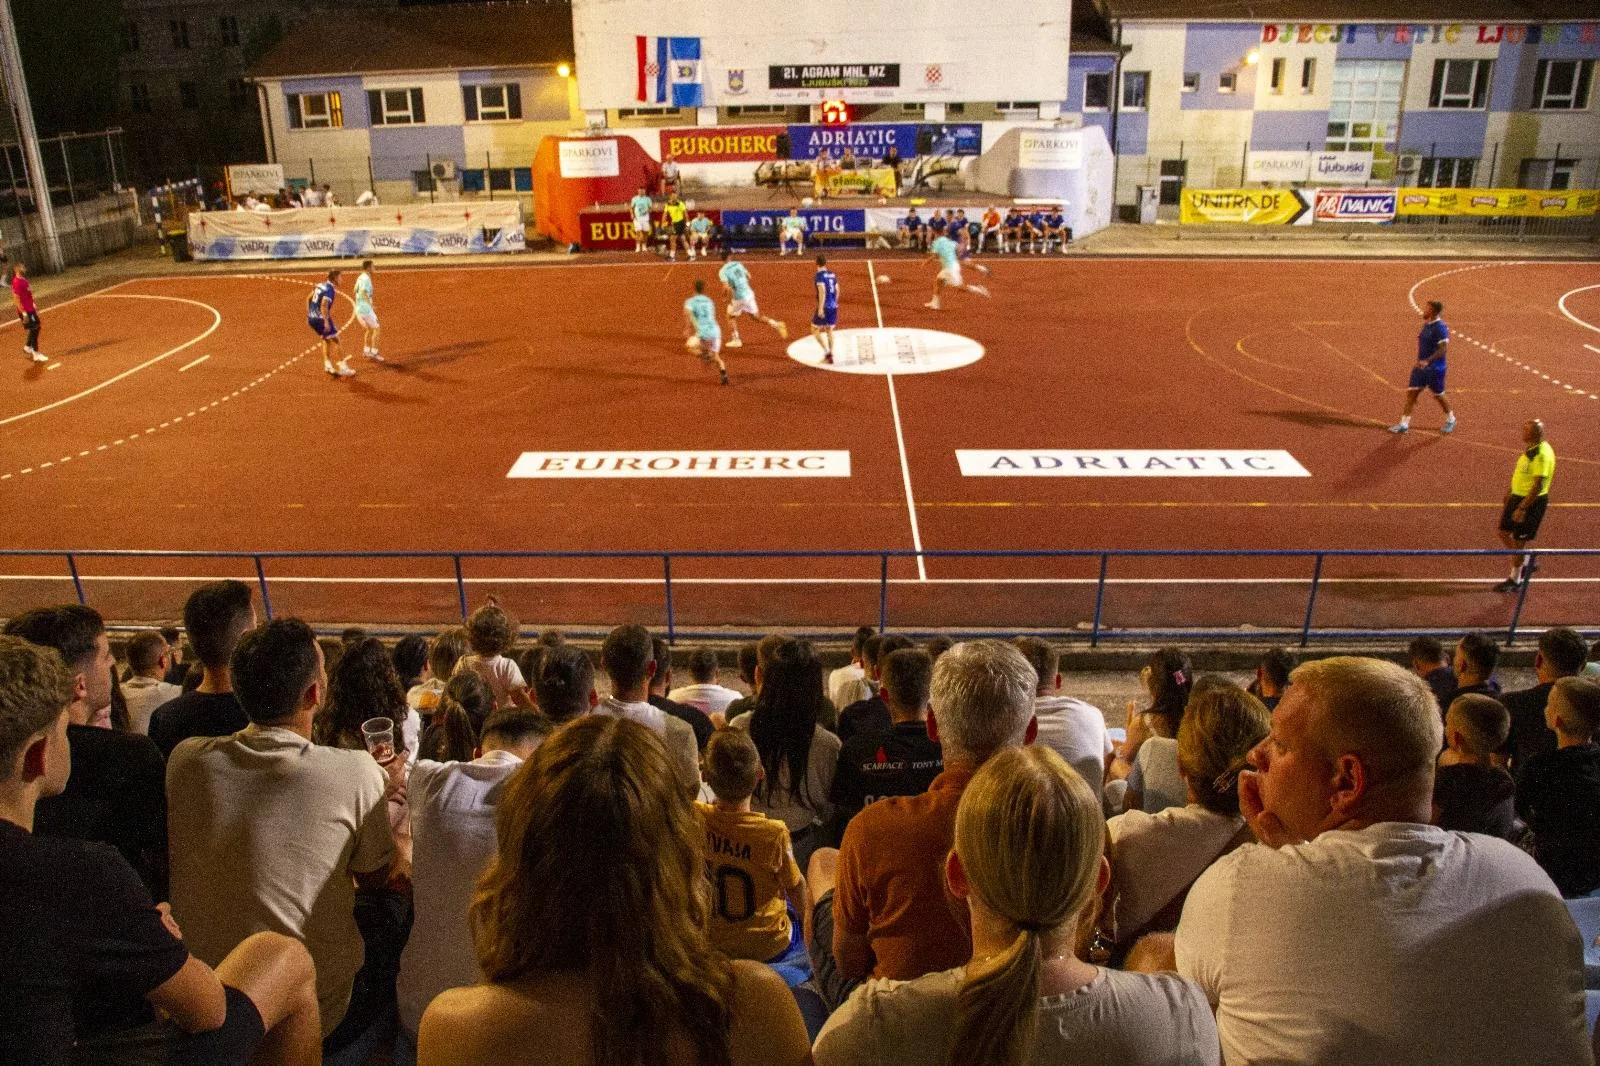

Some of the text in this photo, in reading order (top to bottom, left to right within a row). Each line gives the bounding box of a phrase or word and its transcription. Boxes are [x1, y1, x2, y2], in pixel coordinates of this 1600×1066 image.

[783, 65, 887, 79] 21. AGRAM MNL MZ
[669, 134, 777, 156] EUROHERC
[808, 129, 896, 146] ADRIATIC
[1032, 139, 1079, 150] PARKOVI
[568, 147, 612, 158] PARKOVI
[1318, 161, 1365, 175] Ljubuški
[1191, 193, 1281, 210] UNITRADE
[535, 455, 827, 472] EUROHERC
[988, 455, 1277, 471] ADRIATIC
[862, 761, 904, 771] SCARFACE
[912, 760, 935, 770] TONY
